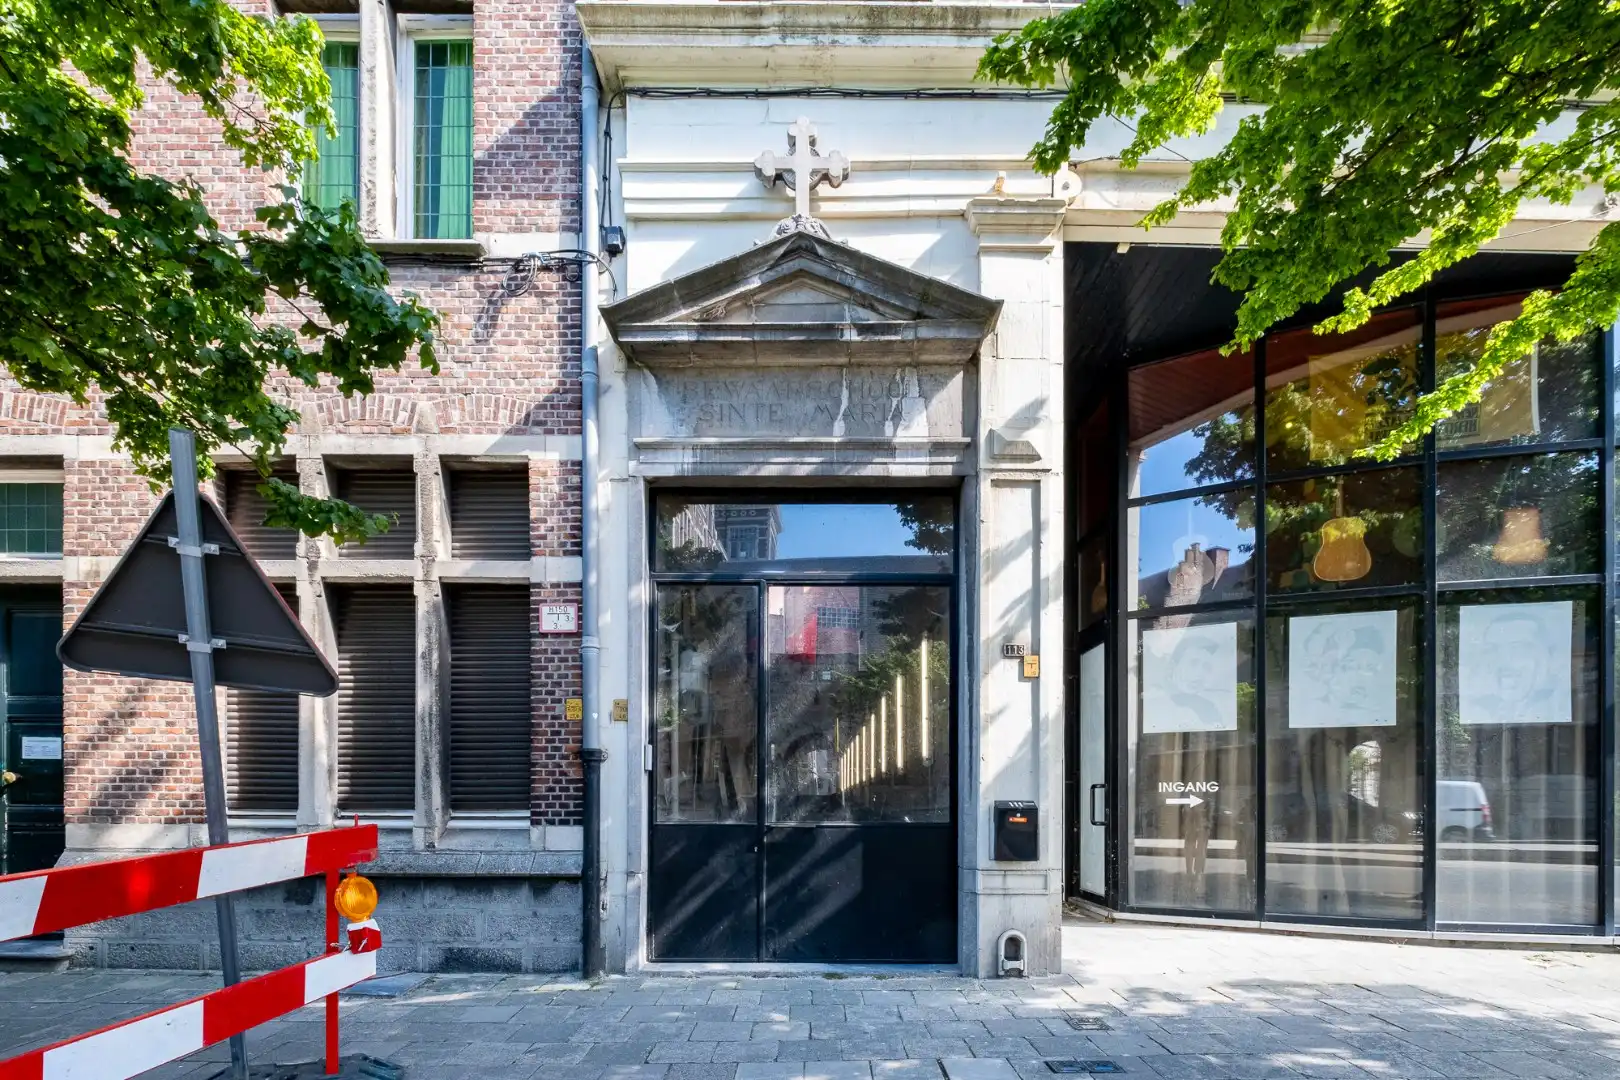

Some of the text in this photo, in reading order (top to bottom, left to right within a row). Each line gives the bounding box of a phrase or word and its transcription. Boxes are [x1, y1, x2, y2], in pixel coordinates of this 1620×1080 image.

[696, 403, 907, 422] SINTE MARIA
[1007, 645, 1024, 655] 113
[1158, 781, 1220, 793] INGANG
